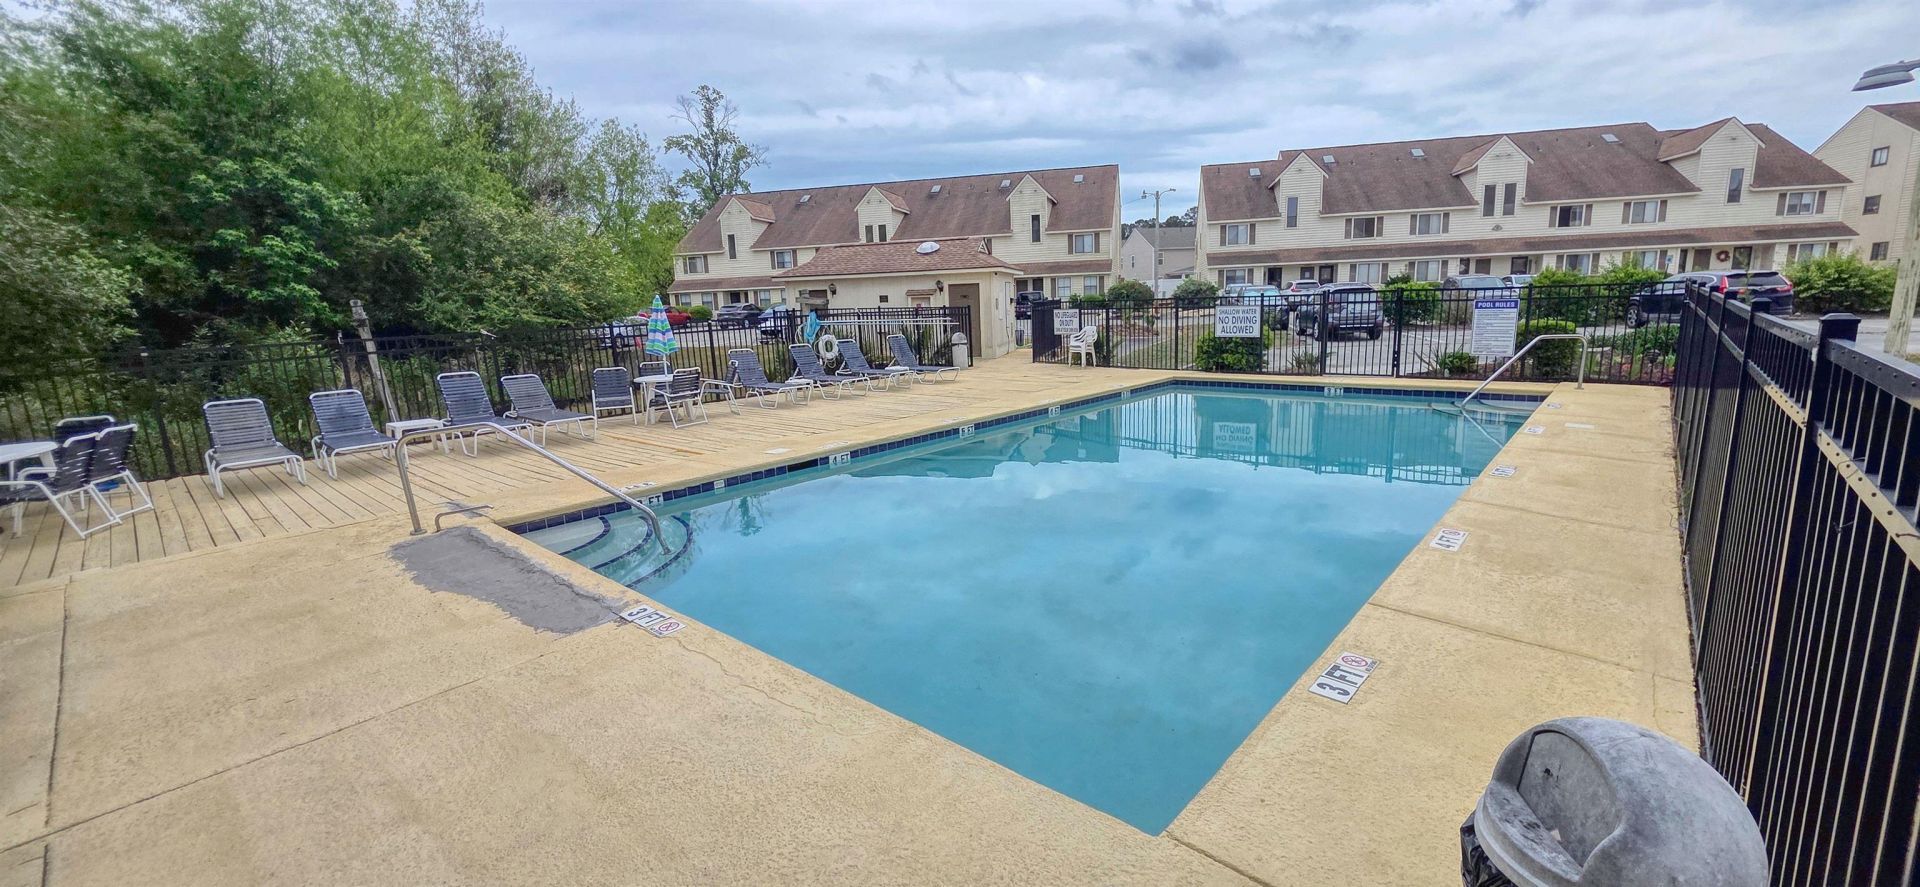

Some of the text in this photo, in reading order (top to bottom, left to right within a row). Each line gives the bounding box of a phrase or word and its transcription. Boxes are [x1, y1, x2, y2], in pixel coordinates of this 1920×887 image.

[1218, 316, 1257, 325] NO DIVING
[1221, 326, 1254, 334] ALLOWED
[841, 453, 850, 464] FT
[648, 495, 661, 505] FT
[627, 607, 666, 625] 3 FT
[1316, 664, 1365, 696] 3 FT
